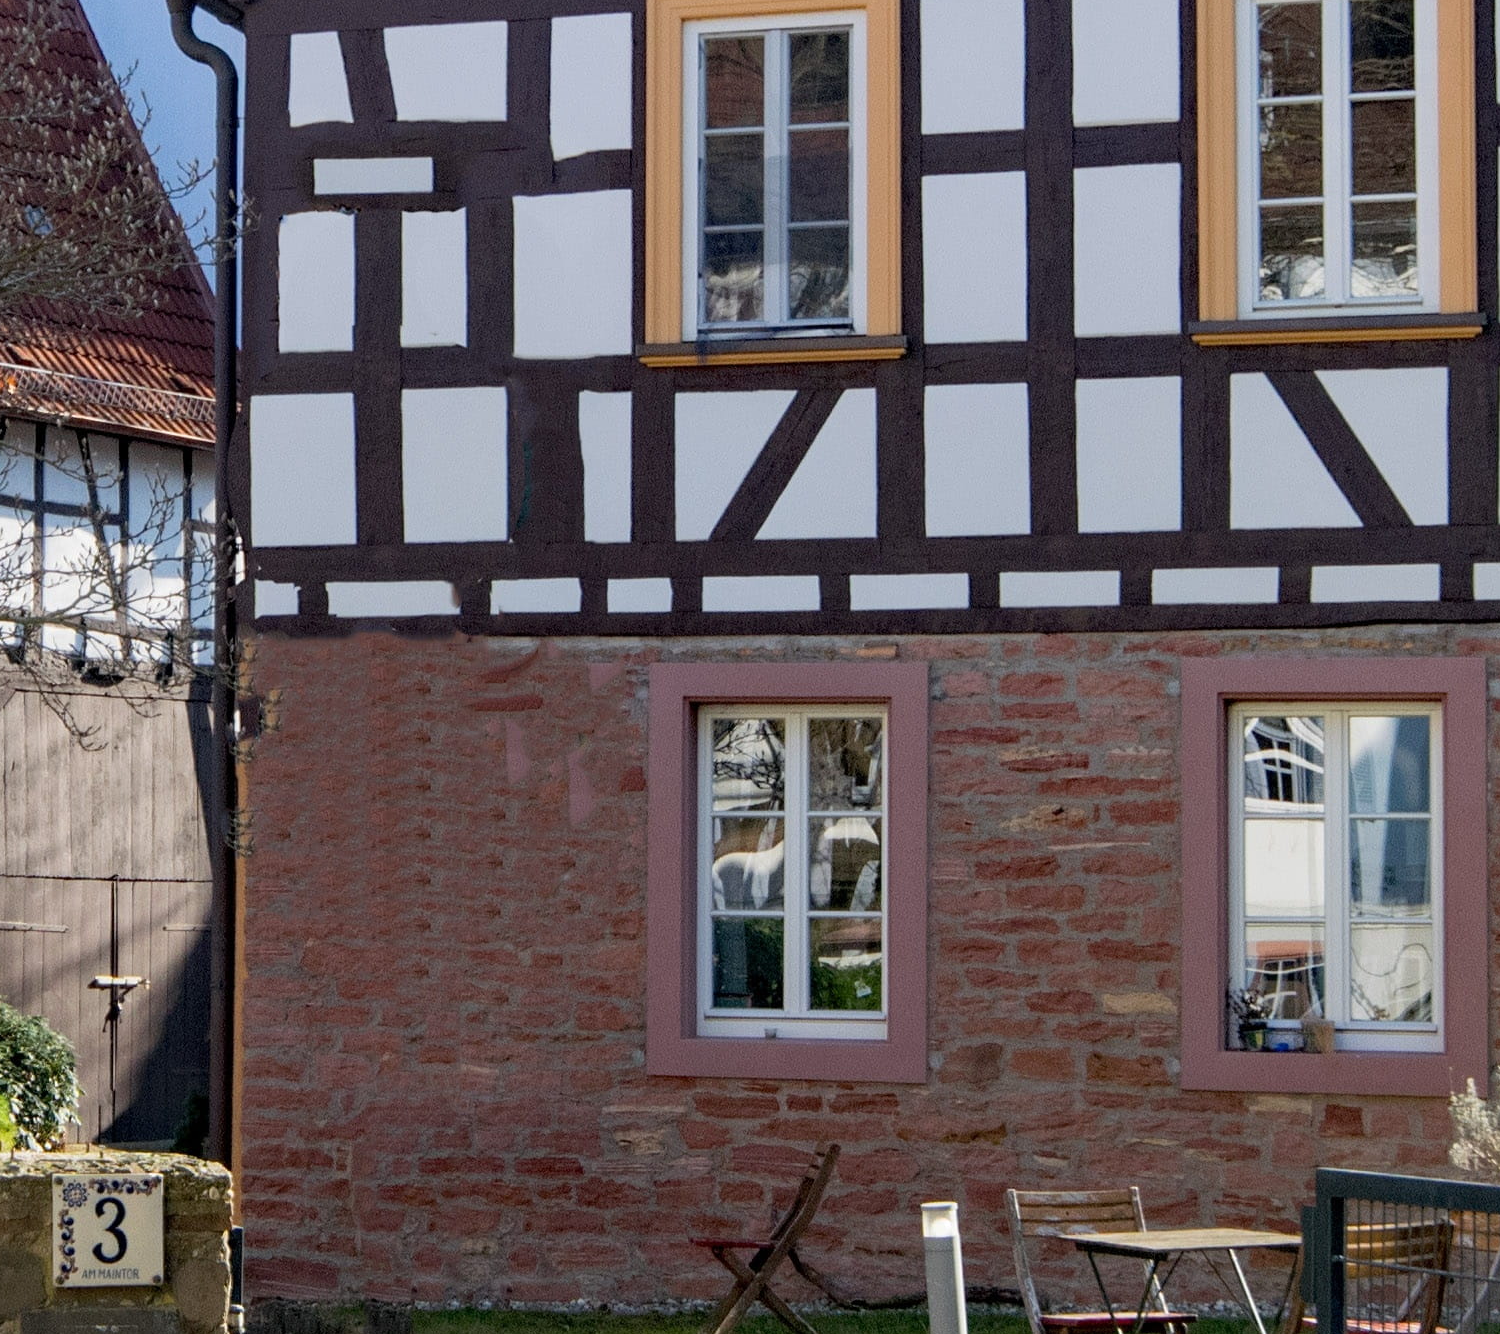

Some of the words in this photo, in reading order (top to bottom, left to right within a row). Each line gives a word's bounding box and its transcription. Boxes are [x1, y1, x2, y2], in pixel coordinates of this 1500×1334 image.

[92, 1197, 128, 1264] 3
[81, 1269, 96, 1279] AM
[98, 1268, 140, 1280] MAINTOR
